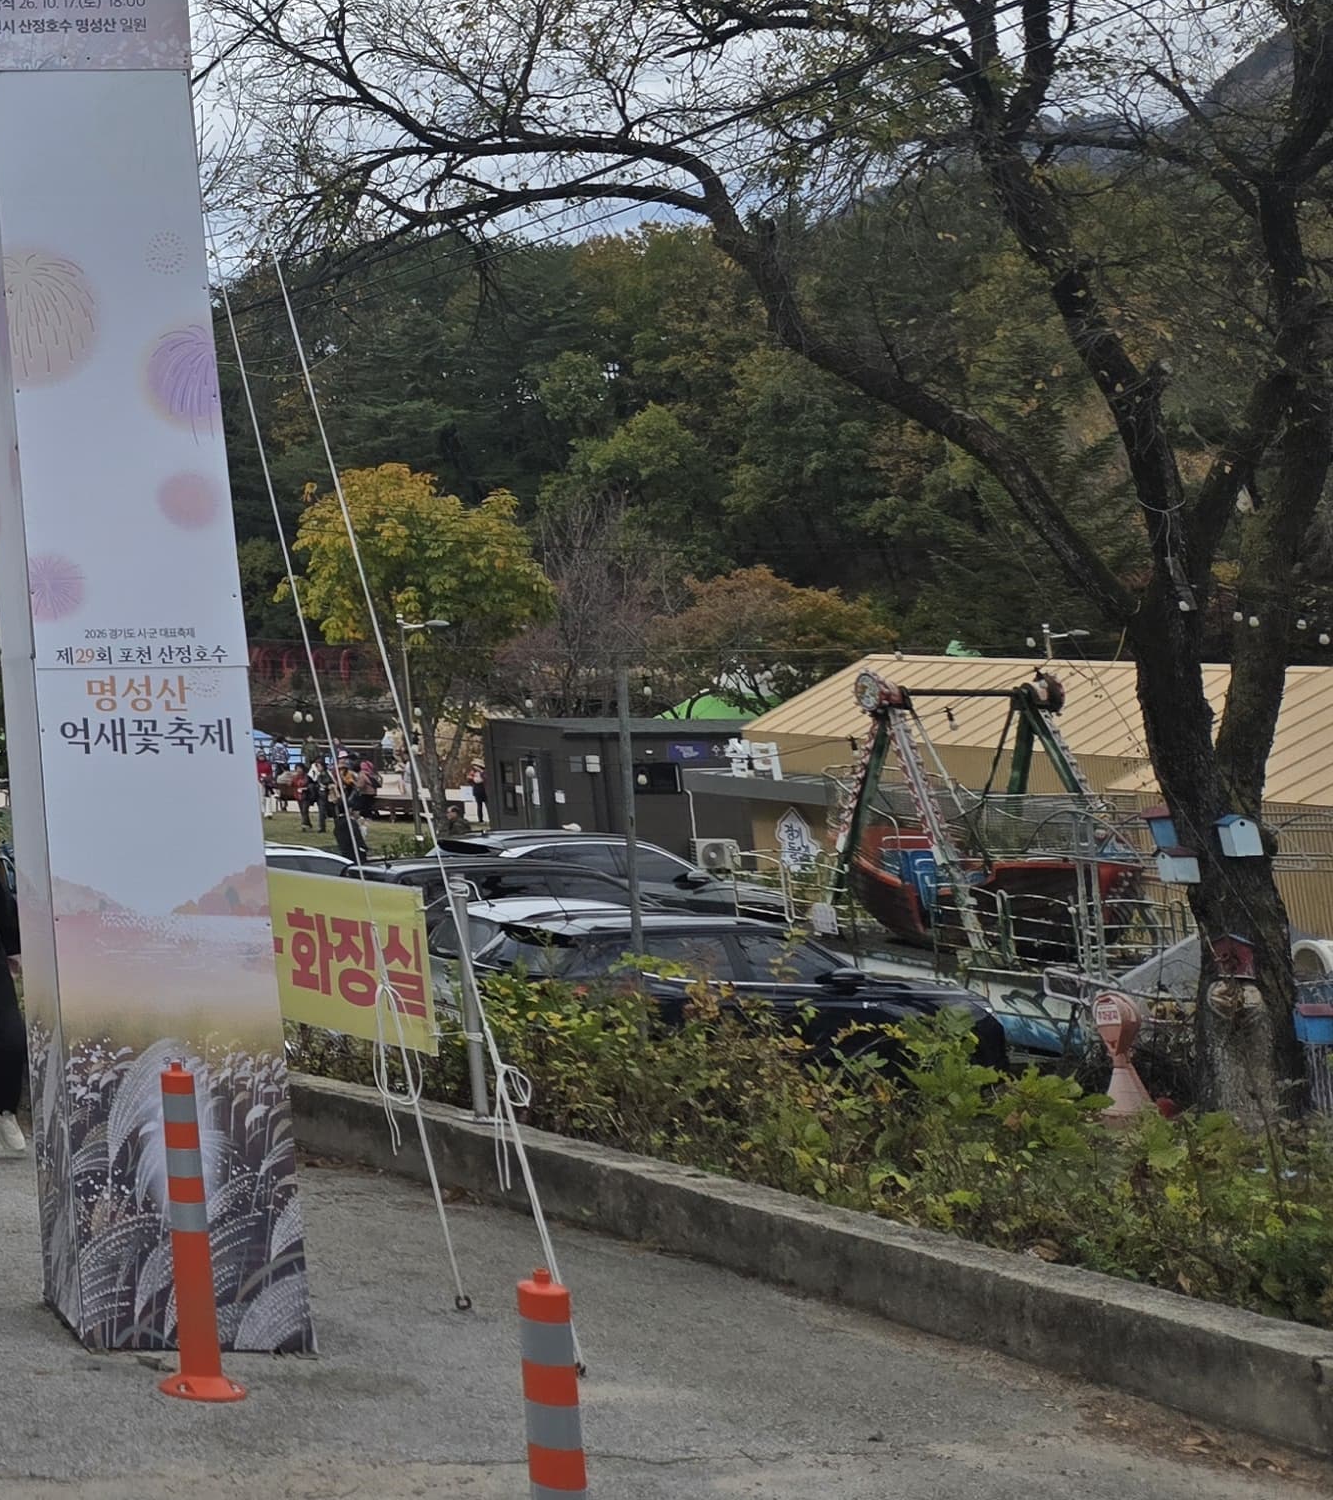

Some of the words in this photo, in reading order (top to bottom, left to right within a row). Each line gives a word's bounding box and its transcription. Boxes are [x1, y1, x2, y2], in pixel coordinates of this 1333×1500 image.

[18, 19, 72, 34] 산정호수
[75, 18, 116, 33] 명성산
[120, 17, 147, 33] 일원
[85, 628, 108, 639] 2026
[109, 627, 135, 639] 경기도
[159, 627, 196, 639] 대표축제
[56, 645, 112, 665] 제29회
[118, 645, 152, 665] 포천
[158, 644, 228, 664] 산정호수
[87, 674, 190, 712] 명성산
[60, 716, 234, 755] 억새꽃축제
[286, 907, 427, 1019] 화장실
